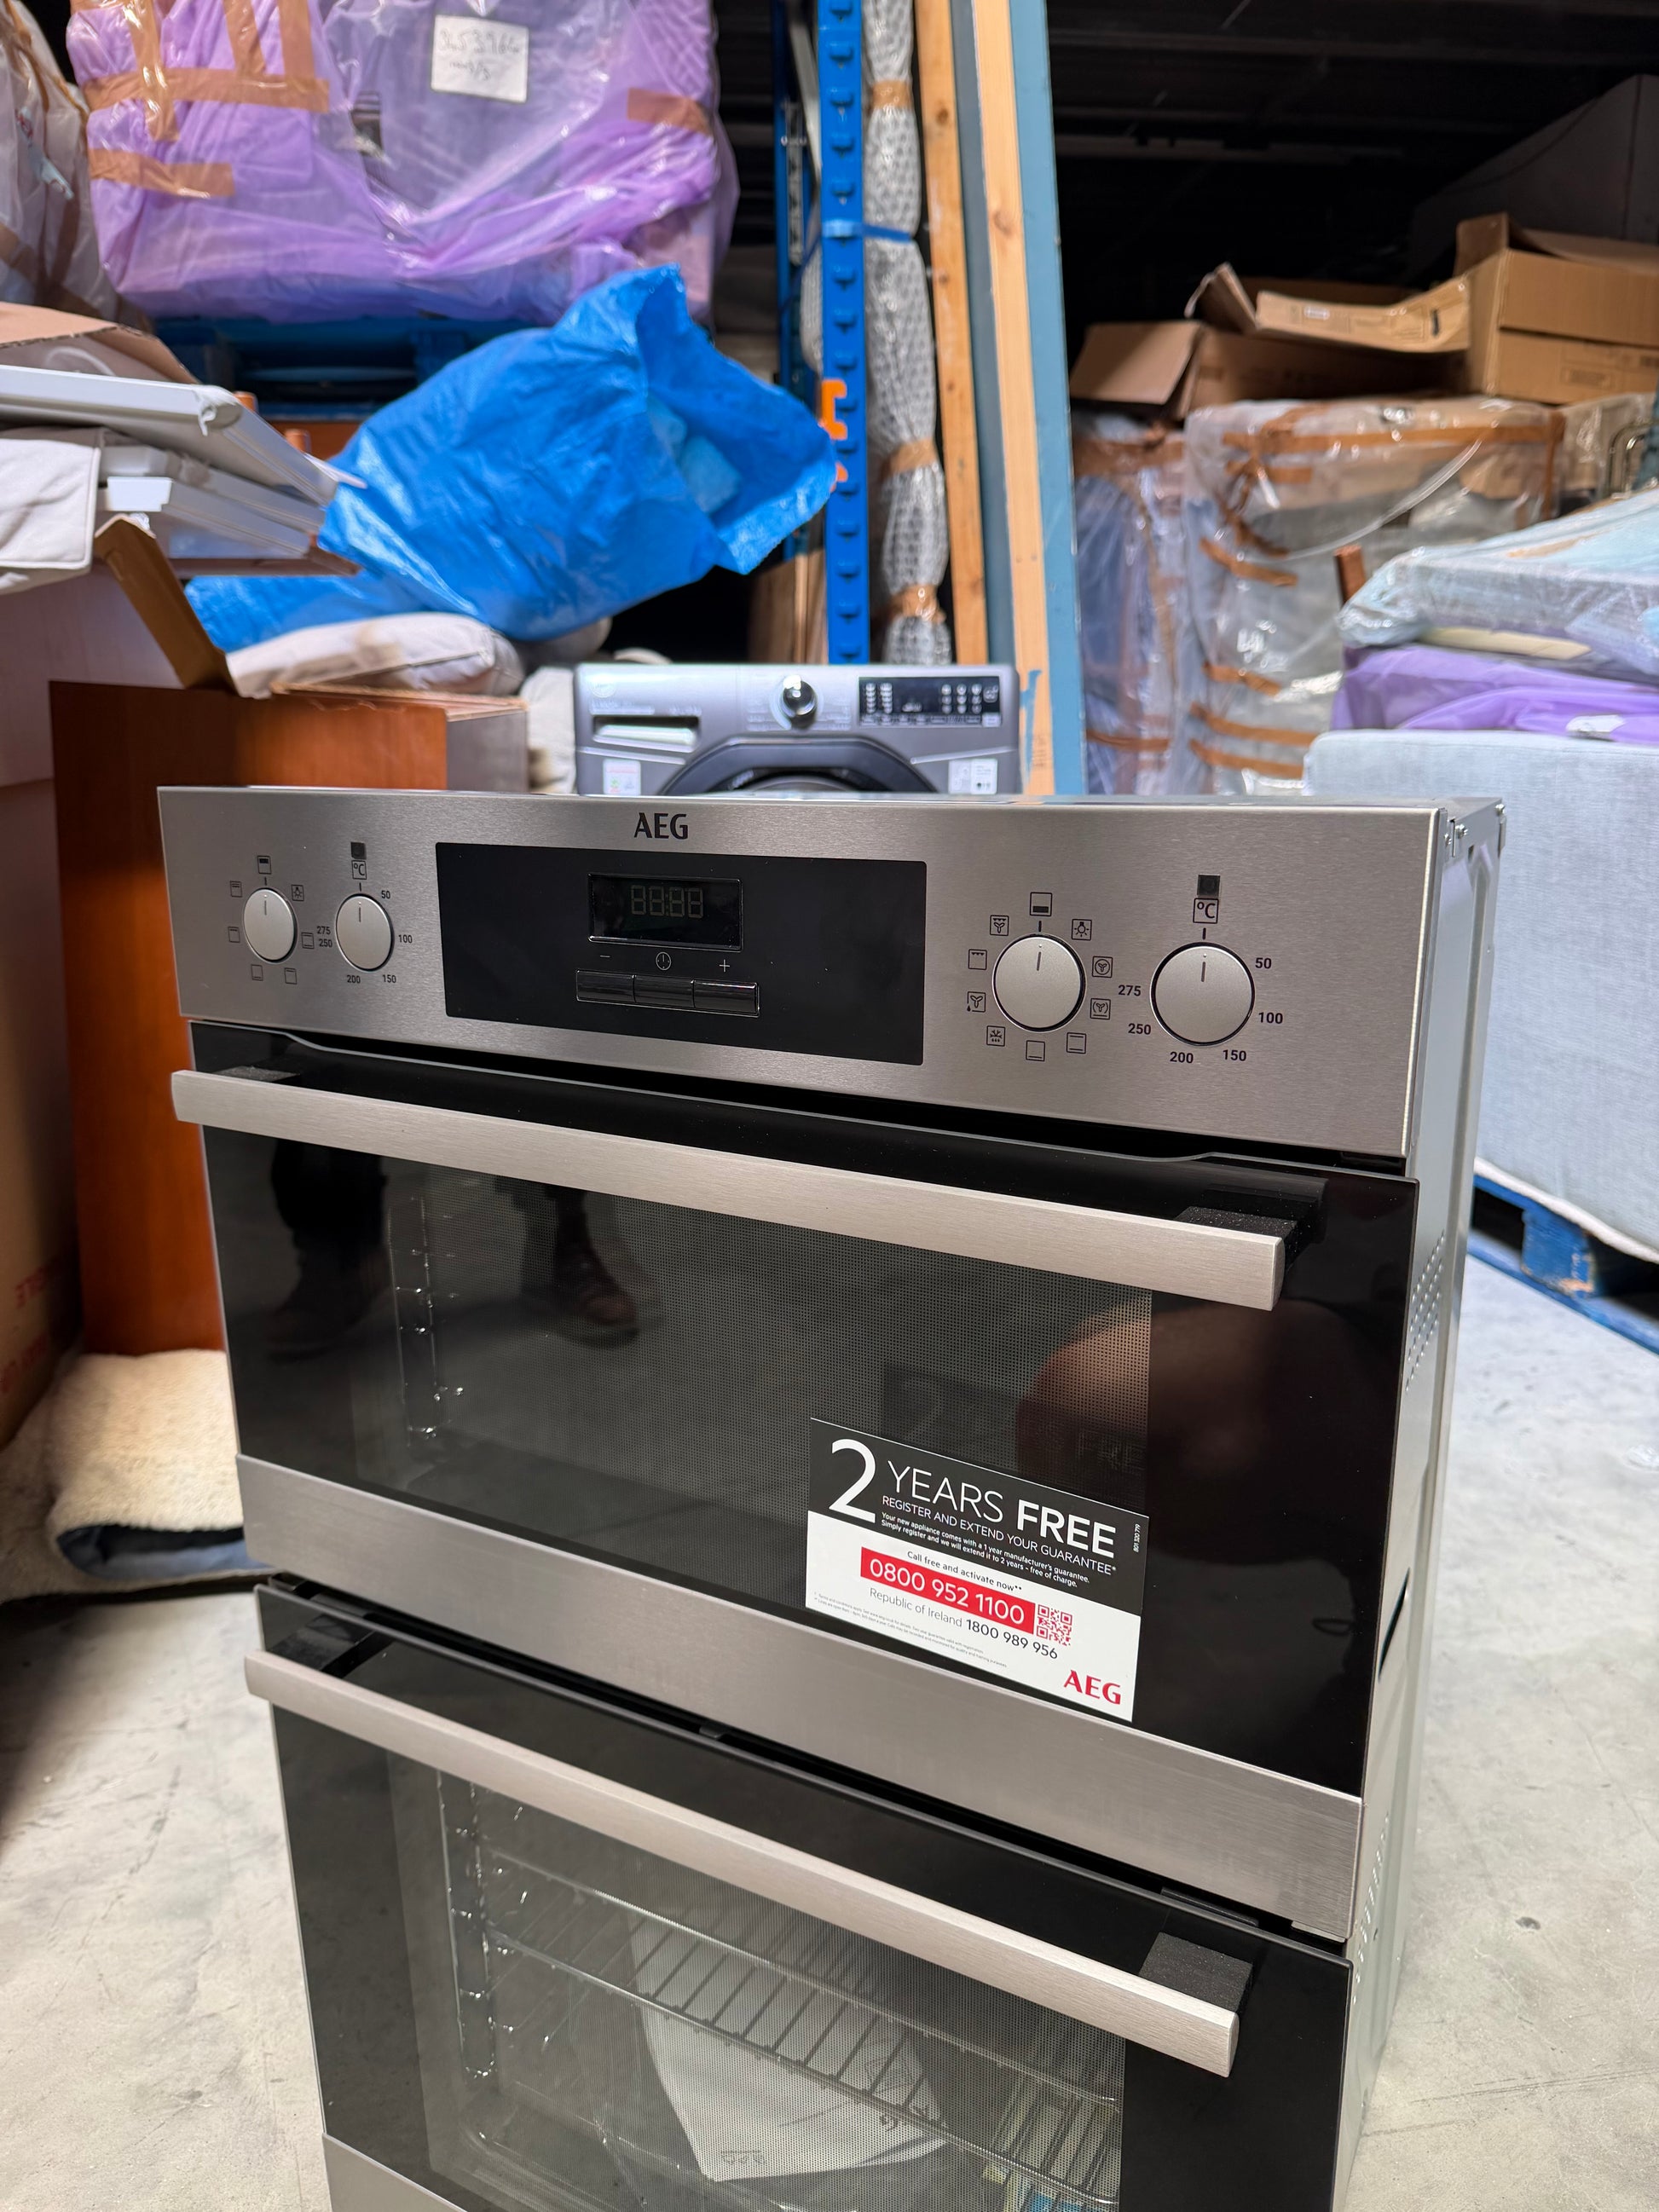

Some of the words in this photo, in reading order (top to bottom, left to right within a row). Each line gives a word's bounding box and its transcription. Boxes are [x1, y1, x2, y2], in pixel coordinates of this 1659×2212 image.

[633, 812, 689, 840] AEG
[381, 891, 390, 899] 50
[316, 926, 331, 935] 275
[319, 939, 332, 948] 250
[398, 934, 413, 944] 100
[1255, 957, 1272, 969] 50
[347, 974, 361, 984] 200
[383, 974, 396, 984] 150
[1118, 985, 1142, 996] 275
[1258, 1012, 1284, 1025] 100
[1128, 1023, 1152, 1035] 250
[1170, 1051, 1194, 1064] 200
[1223, 1049, 1247, 1062] 150
[829, 1438, 876, 1523] 2
[887, 1460, 1003, 1523] YEARS
[1017, 1499, 1116, 1558] FREE
[882, 1495, 931, 1519] REGISTER
[934, 1512, 957, 1527] AND
[960, 1519, 1004, 1541] EXTEND
[1007, 1533, 1038, 1552] YOUR
[882, 1512, 896, 1522] Your
[910, 1521, 940, 1535] appliance
[941, 1532, 962, 1543] comes
[962, 1537, 976, 1547] with
[988, 1546, 1003, 1556] year
[1054, 1567, 1090, 1584] guarantee.
[882, 1520, 902, 1532] Simply
[902, 1527, 926, 1539] register
[928, 1534, 939, 1544] and
[951, 1541, 962, 1550] will
[962, 1545, 985, 1557] extend
[992, 1554, 999, 1562] to
[1006, 1559, 1024, 1571] years
[1030, 1567, 1043, 1577] free
[1044, 1570, 1052, 1579] of
[1053, 1574, 1078, 1588] charge.
[907, 1551, 922, 1562] Call
[924, 1556, 940, 1568] free
[942, 1563, 958, 1574] and
[961, 1569, 994, 1586] activate
[870, 1558, 925, 1591] 0800
[933, 1577, 968, 1608] 952
[975, 1594, 1025, 1625] 1100
[870, 1587, 912, 1611] Republic
[915, 1603, 927, 1614] of
[928, 1607, 962, 1627] Ireland
[966, 1619, 999, 1639] 1800
[1003, 1632, 1028, 1649] 989
[1032, 1641, 1058, 1660] 956
[1063, 1669, 1122, 1706] AEG
